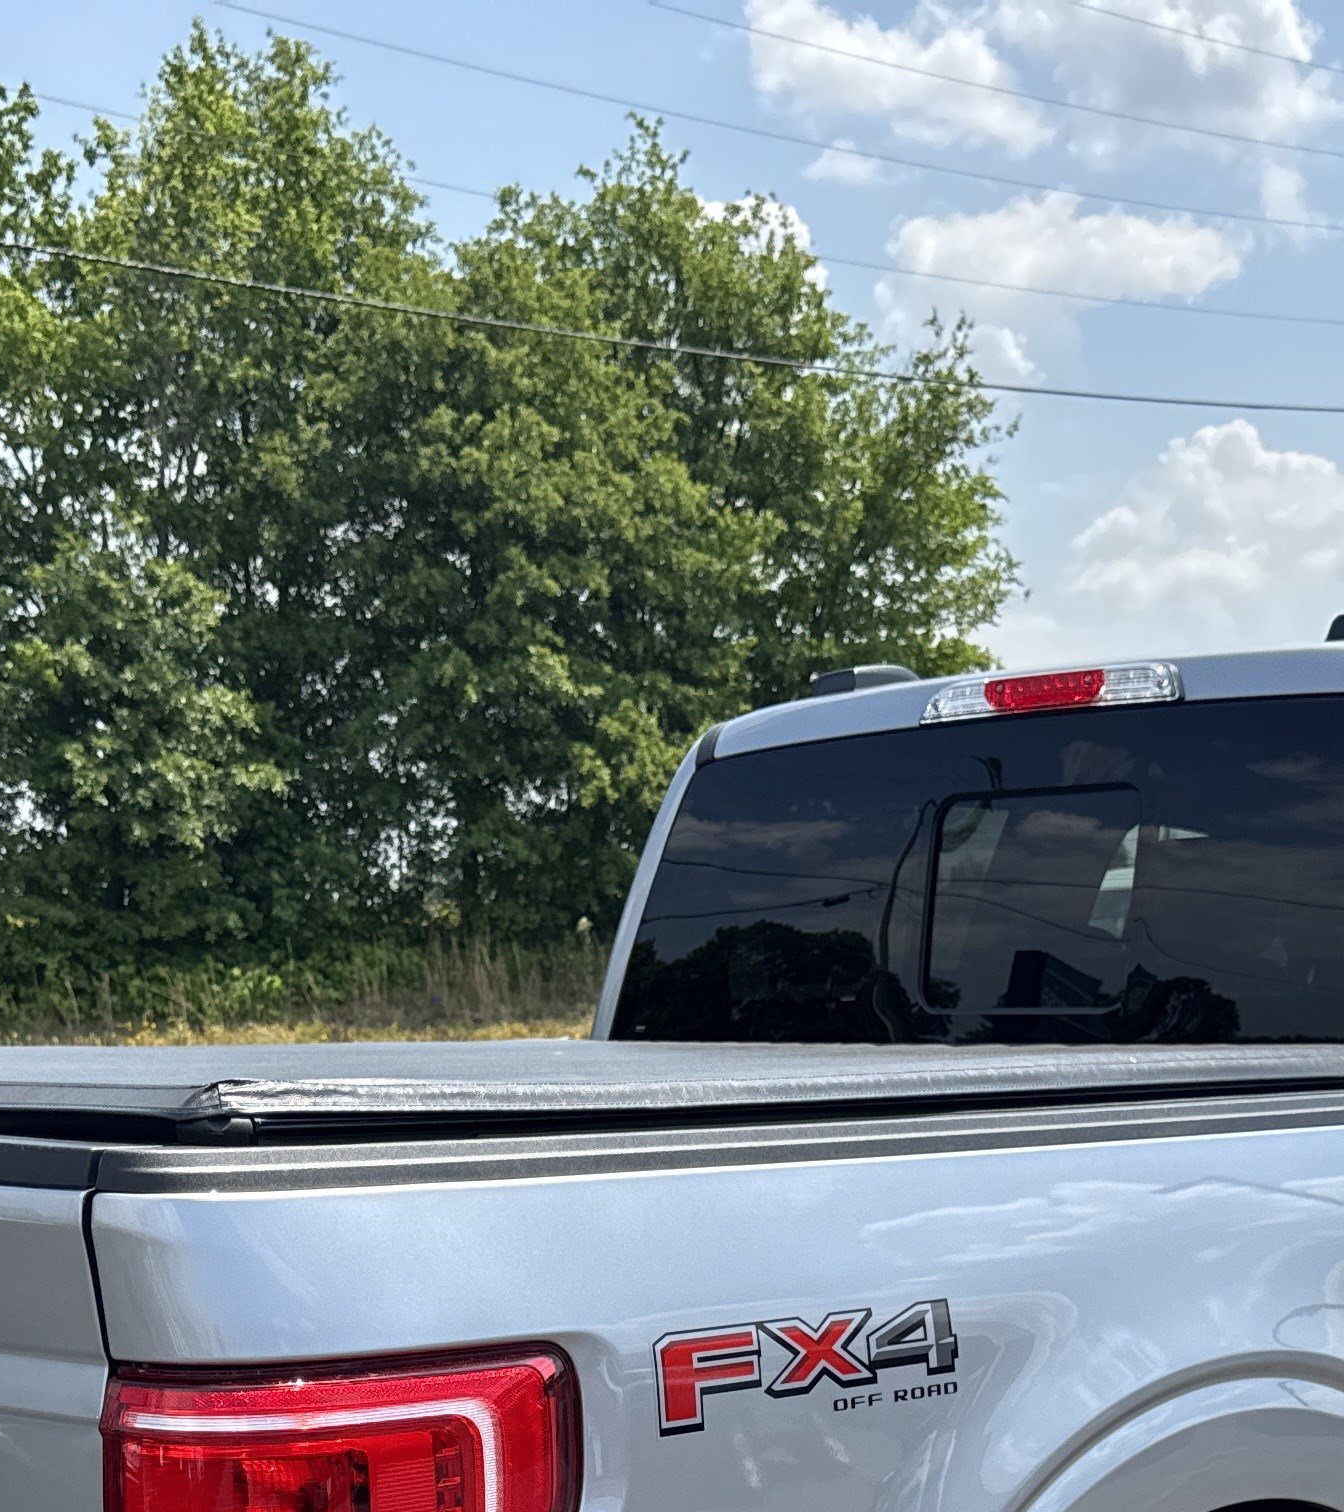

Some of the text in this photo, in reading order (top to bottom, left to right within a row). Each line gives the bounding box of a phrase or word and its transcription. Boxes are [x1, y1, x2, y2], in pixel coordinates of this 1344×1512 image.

[653, 1298, 959, 1438] FX4
[833, 1380, 958, 1412] OFF ROAD
